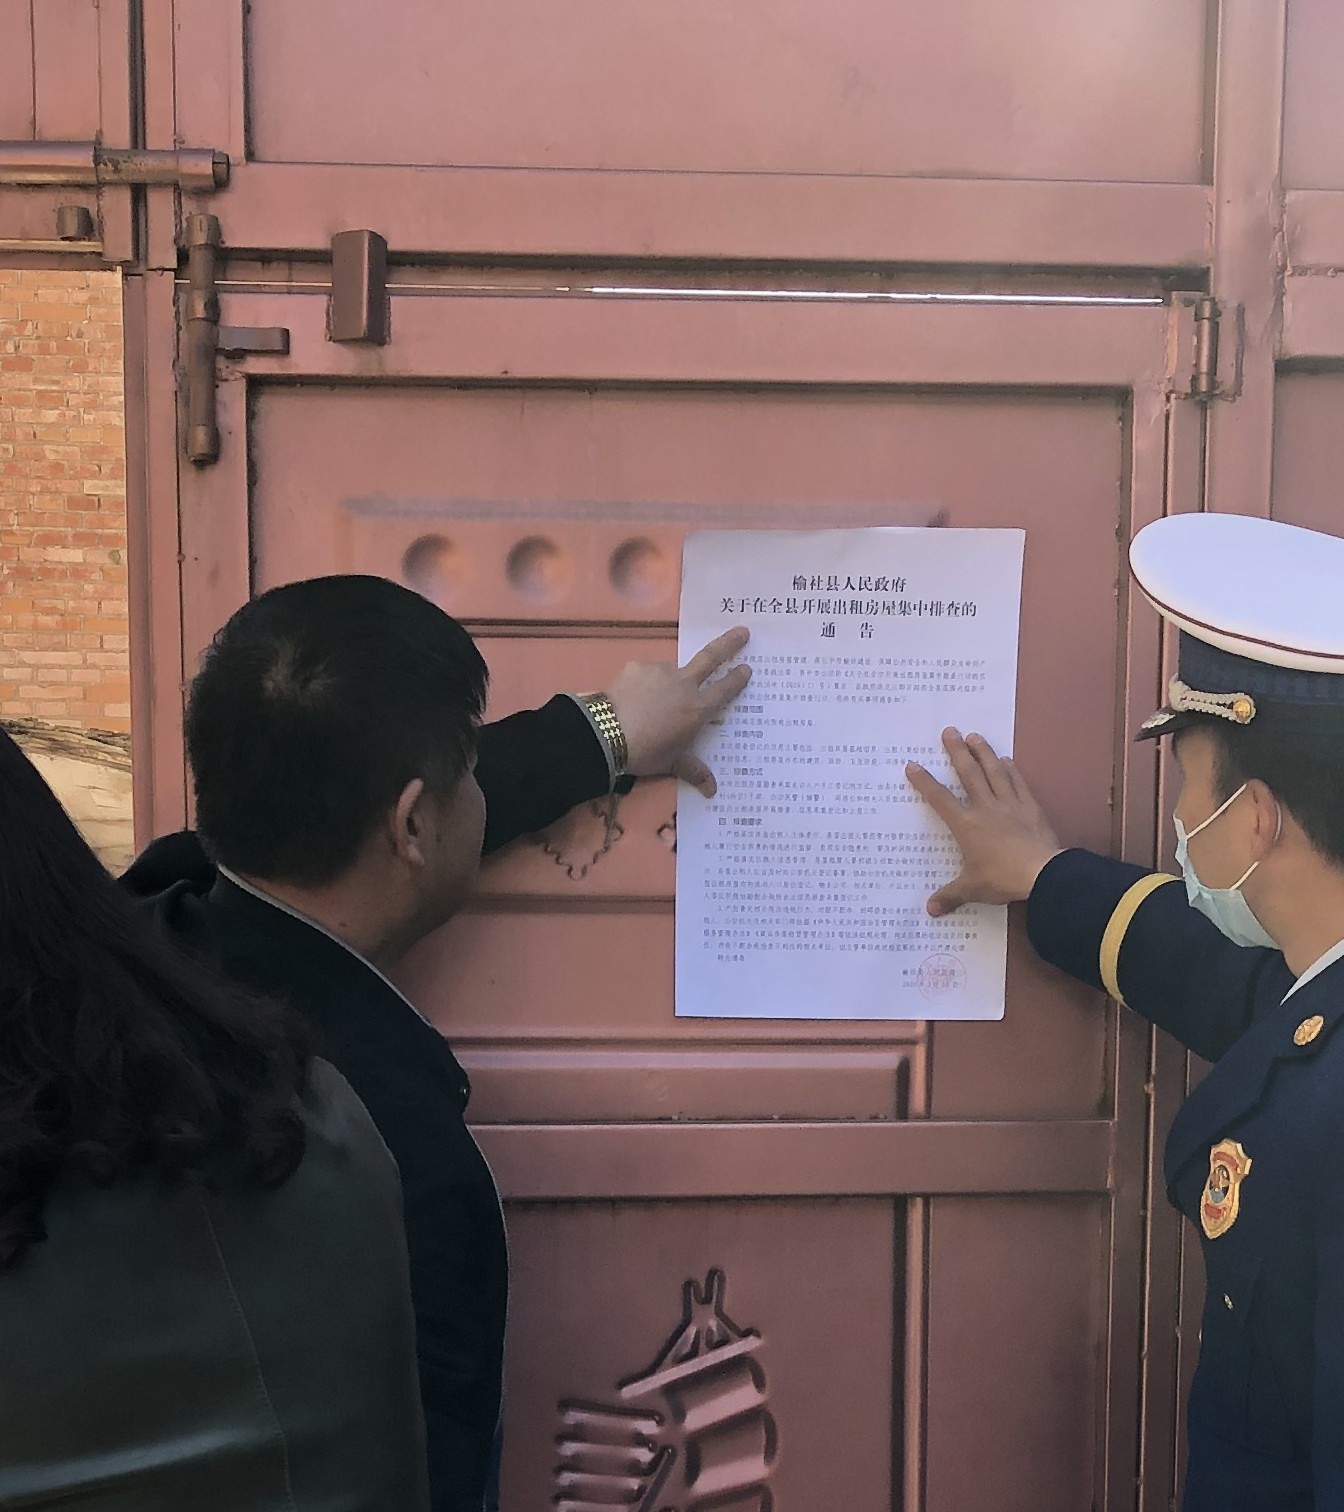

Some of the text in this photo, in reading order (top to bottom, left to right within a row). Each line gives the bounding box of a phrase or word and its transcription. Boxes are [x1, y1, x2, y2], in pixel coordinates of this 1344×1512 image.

[792, 575, 906, 592] 榆社县人民政府
[720, 597, 977, 617] 关于在全县开展出租房屋集中排查的
